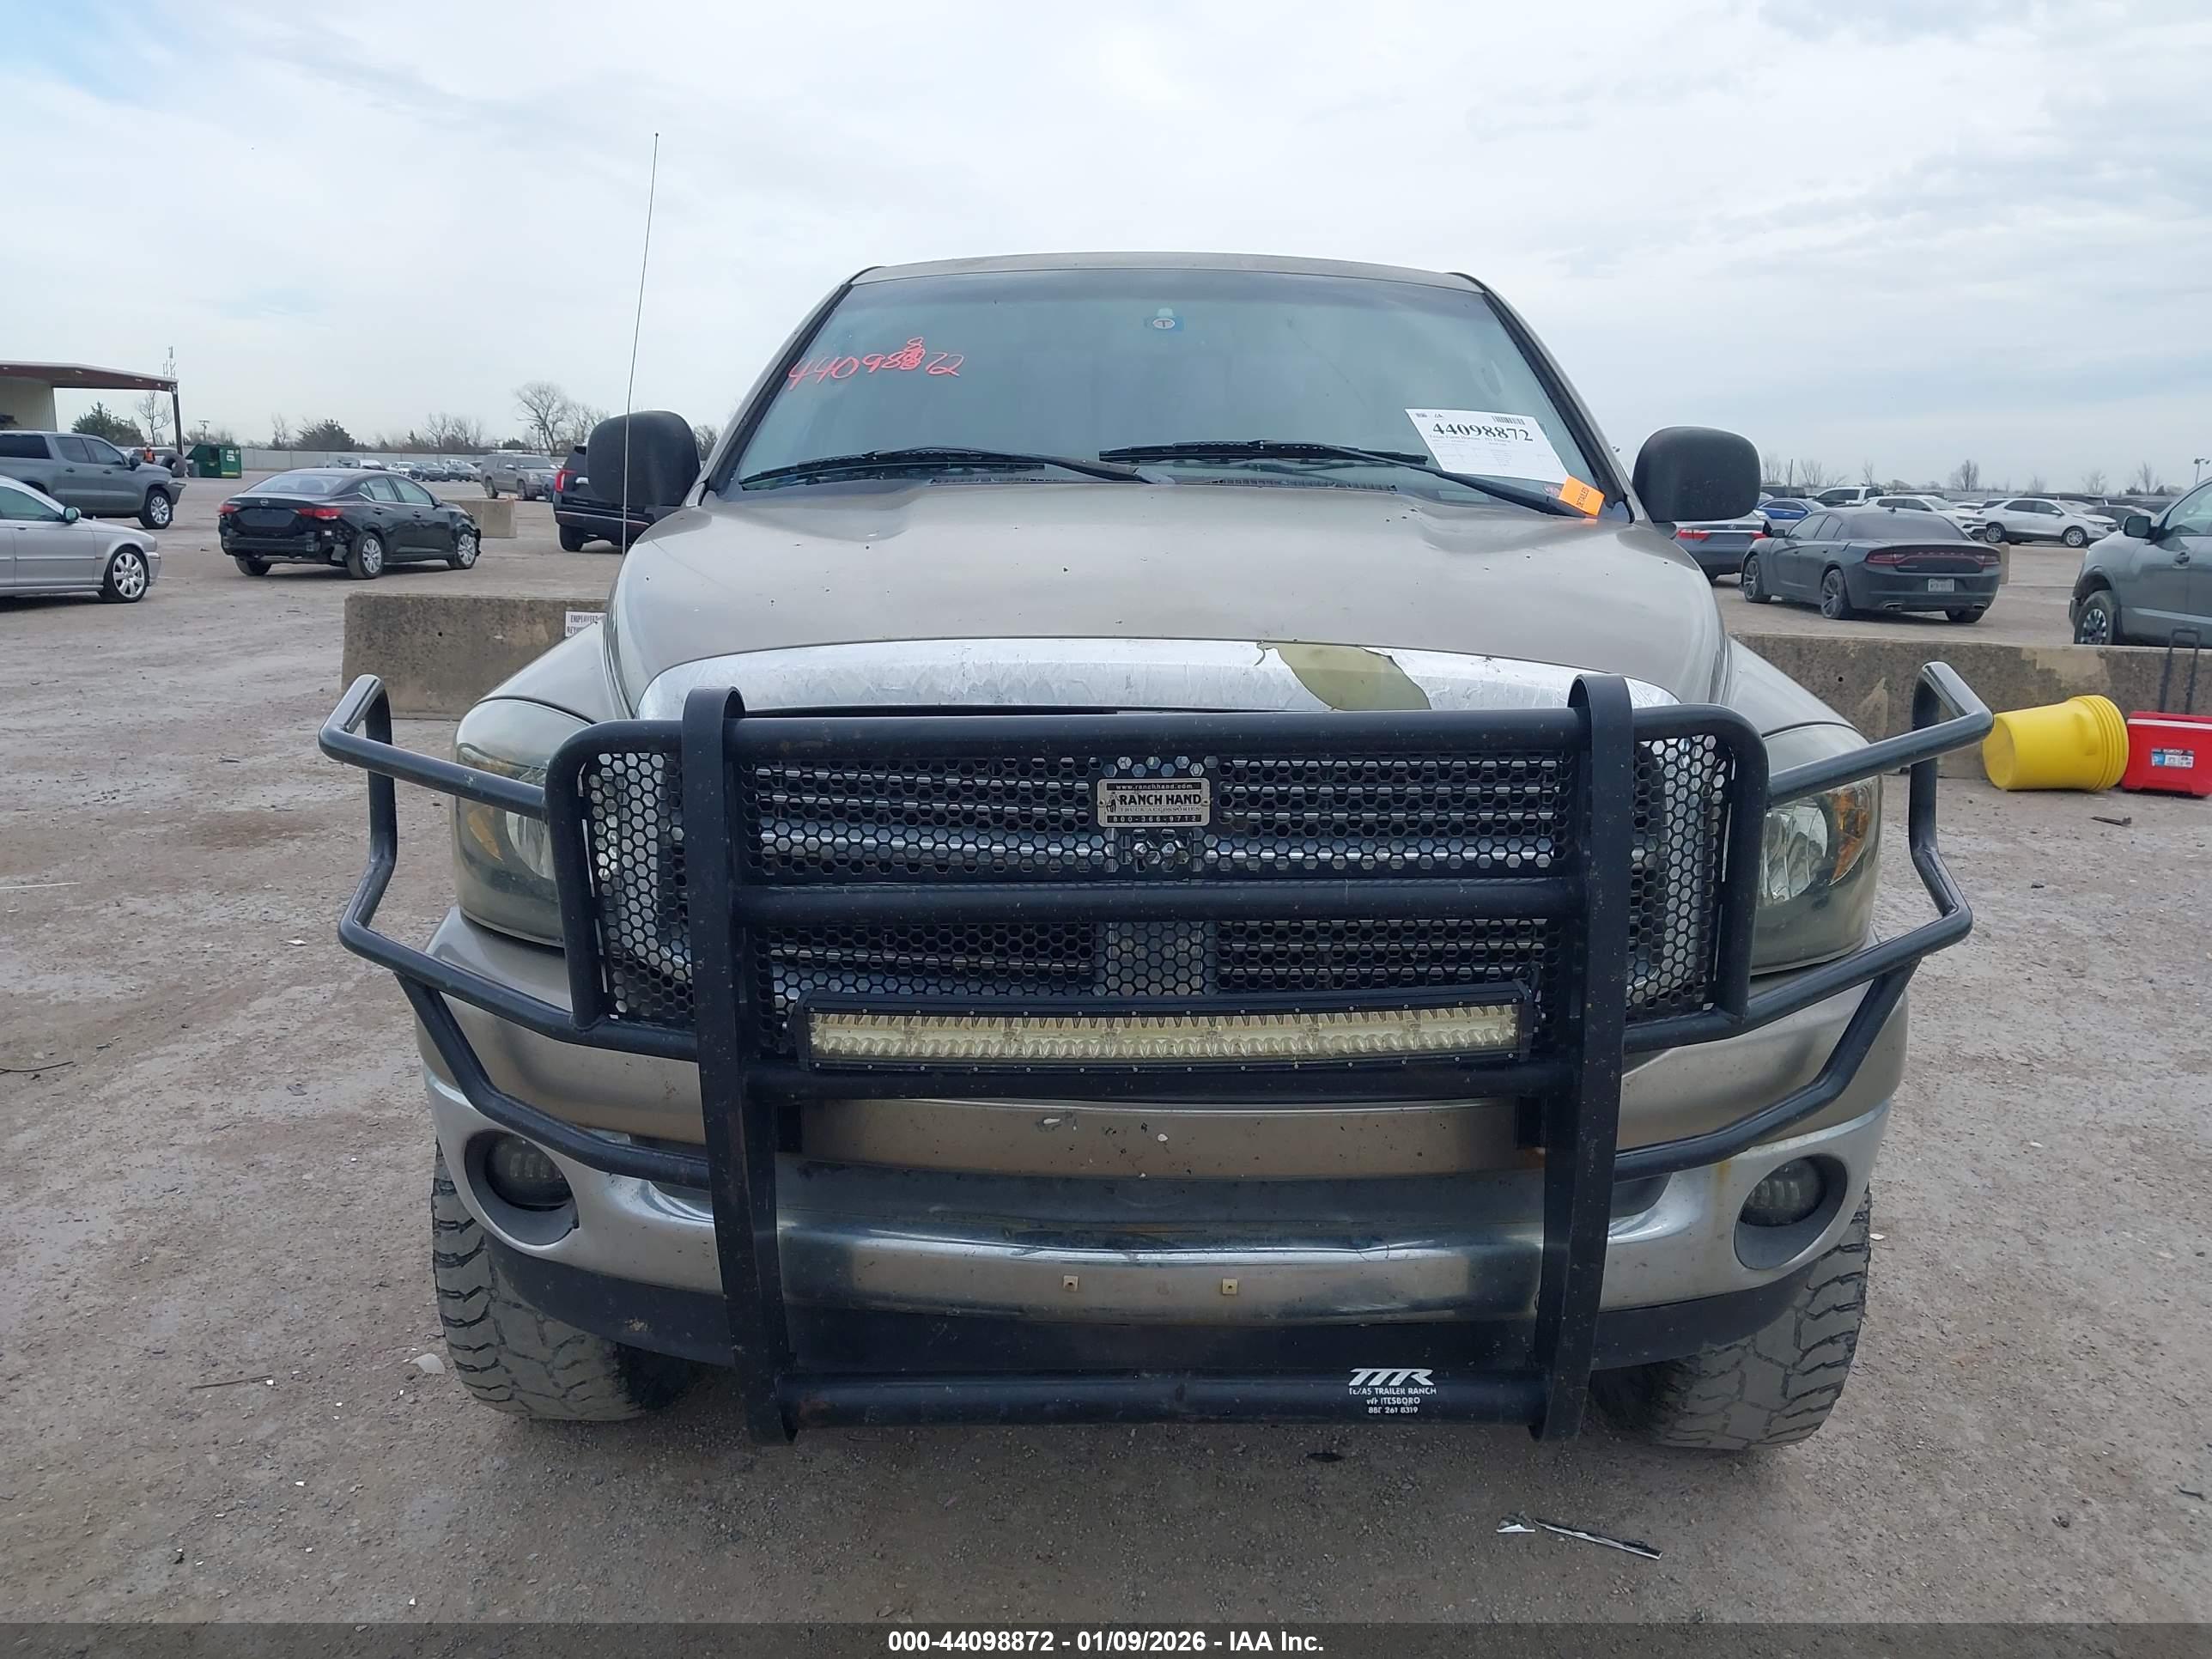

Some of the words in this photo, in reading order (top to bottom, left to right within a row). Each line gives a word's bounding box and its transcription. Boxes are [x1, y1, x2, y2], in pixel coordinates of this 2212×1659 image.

[1432, 422, 1534, 442] 44098872
[1119, 793, 1162, 805] RANCH
[1166, 793, 1201, 805] HAND
[1374, 1387, 1406, 1395] TRAILER
[1408, 1387, 1437, 1395] RANCH
